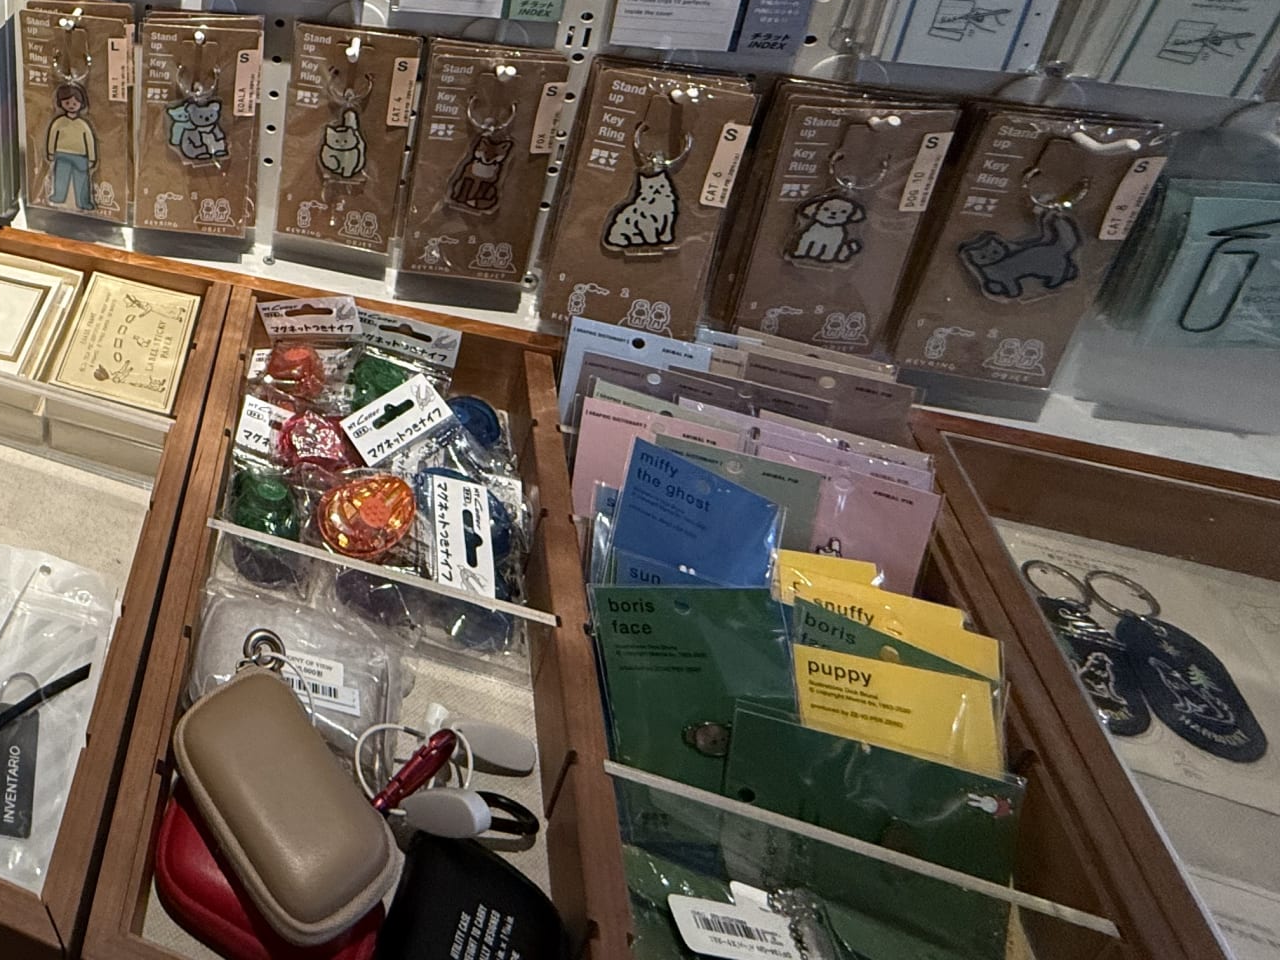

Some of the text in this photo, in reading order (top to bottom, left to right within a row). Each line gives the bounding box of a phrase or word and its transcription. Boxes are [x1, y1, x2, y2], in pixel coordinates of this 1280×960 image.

[518, 8, 552, 18] INDEX
[25, 17, 51, 28] Stand
[150, 31, 178, 42] Stand
[303, 32, 332, 45] Stand
[28, 43, 44, 53] Key
[111, 40, 120, 51] L
[150, 41, 163, 50] up
[303, 43, 316, 53] up
[747, 40, 788, 51] INDEX
[28, 53, 48, 65] Ring
[150, 58, 167, 69] Key
[239, 52, 250, 64] S
[300, 61, 318, 72] Key
[397, 60, 409, 72] S
[442, 63, 474, 75] Stand
[149, 69, 170, 80] Ring
[300, 71, 321, 85] Ring
[440, 73, 454, 84] up
[546, 85, 559, 97] S
[611, 80, 648, 97] Stand
[237, 87, 246, 115] KOALA
[437, 92, 457, 103] Key
[608, 93, 625, 105] up
[391, 104, 402, 123] CAT
[435, 102, 459, 115] Ring
[602, 112, 626, 127] Key
[802, 116, 841, 129] Stand
[598, 126, 626, 142] Ring
[724, 128, 739, 142] S
[799, 127, 817, 138] up
[998, 125, 1040, 140] Stand
[535, 132, 545, 150] FOX
[925, 135, 940, 151] S
[993, 137, 1011, 151] up
[792, 147, 816, 161] Key
[788, 160, 817, 174] Ring
[982, 159, 1010, 173] Key
[1133, 159, 1151, 175] S
[976, 172, 1009, 188] Ring
[704, 183, 717, 202] CAT
[1106, 213, 1123, 235] CAT
[154, 319, 168, 346] STICKY
[270, 323, 354, 333] マグネットつきナイフ
[662, 347, 683, 358] ANIMAL
[588, 410, 643, 429] GRAPHIC DICTIONARY
[367, 407, 443, 459] マグネットつきナイフ
[682, 432, 717, 446] ANIMAL PIN
[639, 451, 679, 479] miffy
[761, 471, 799, 484] ANIMAL PIN
[636, 468, 662, 488] the
[665, 484, 711, 513] ghost
[872, 490, 914, 506] ANIMAL PIN
[436, 481, 453, 583] マグネットつきナイフ
[629, 566, 662, 585] sun
[607, 596, 656, 614] boris
[611, 617, 653, 636] face
[804, 611, 857, 646] boris
[286, 655, 305, 664] OINT
[807, 659, 873, 688] puppy
[2, 744, 22, 824] INVENTARIO
[463, 936, 479, 960] EIGHT
[473, 903, 488, 930] CARRY
[483, 908, 502, 947] DESIGNED
[449, 910, 472, 960] UTILITY CASE
